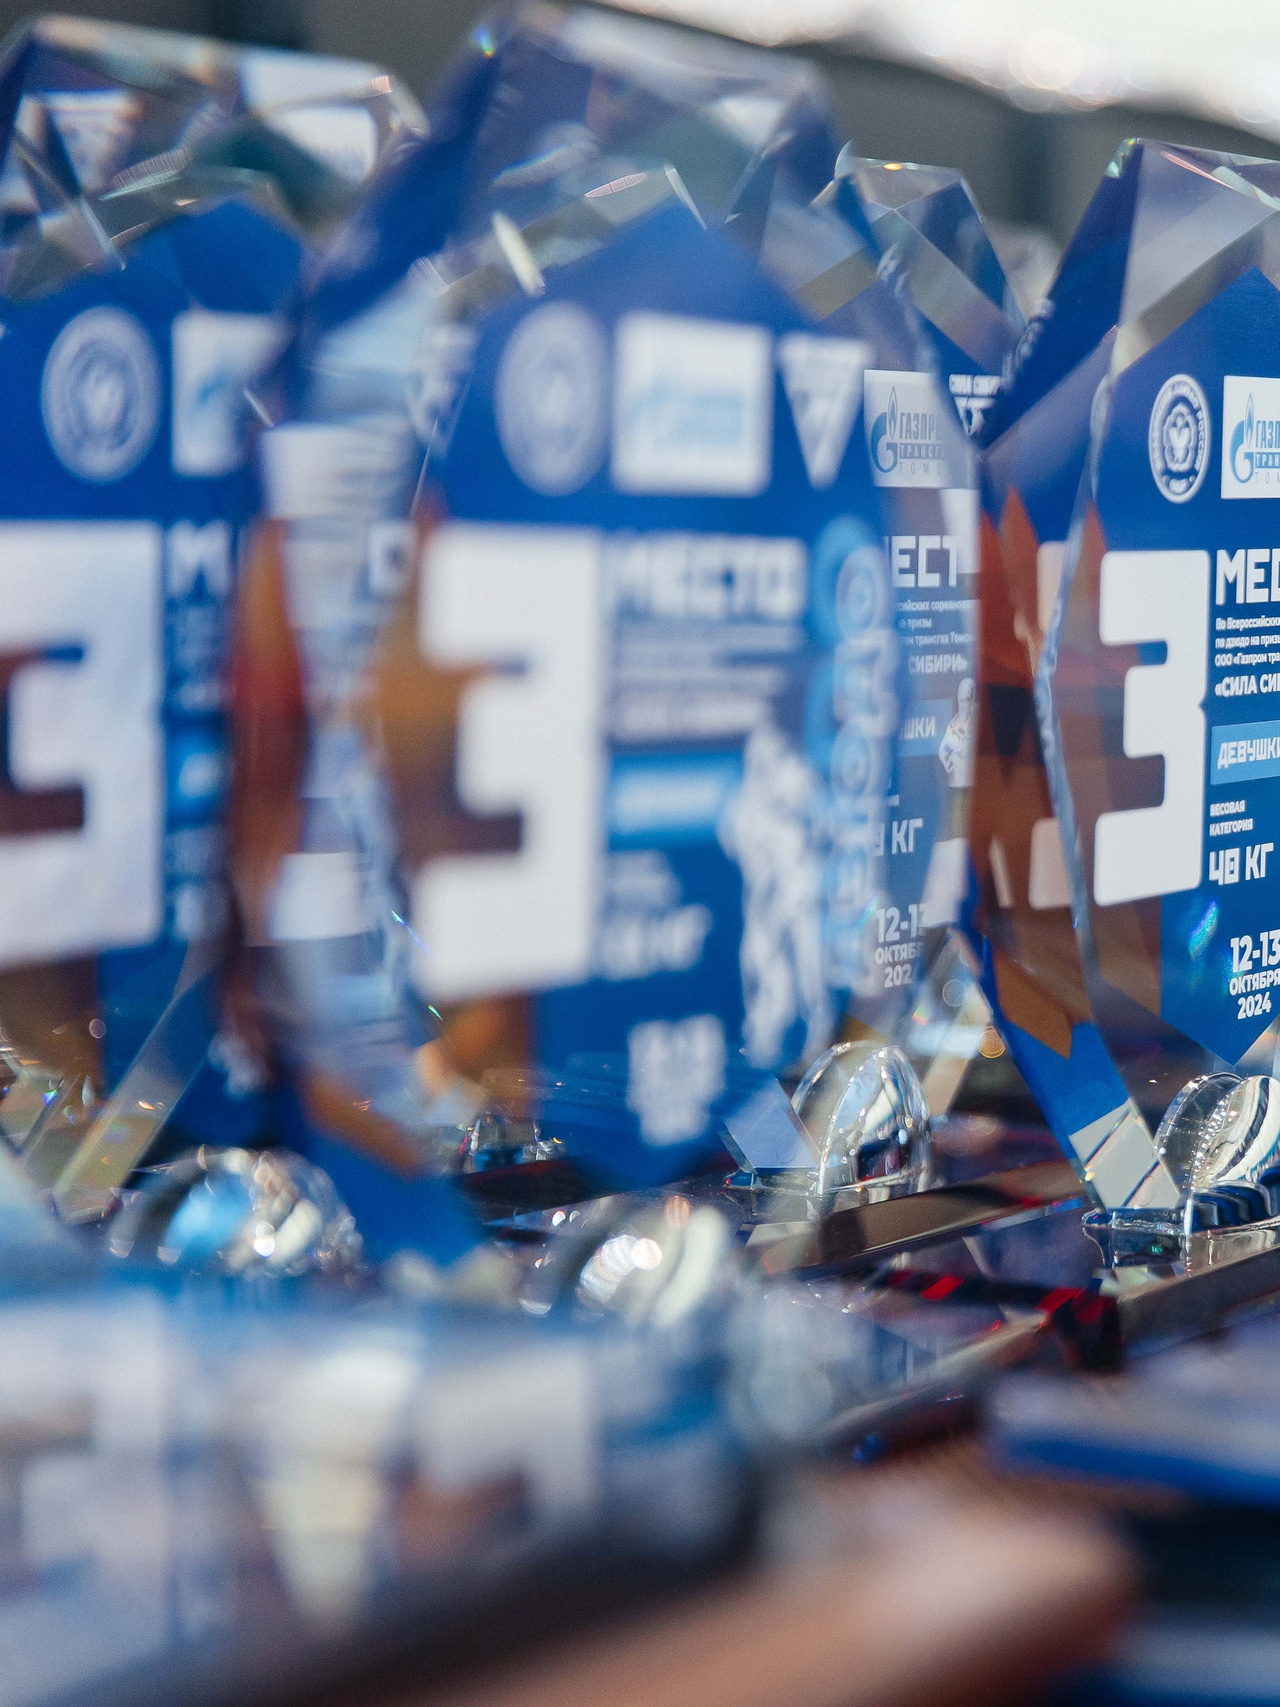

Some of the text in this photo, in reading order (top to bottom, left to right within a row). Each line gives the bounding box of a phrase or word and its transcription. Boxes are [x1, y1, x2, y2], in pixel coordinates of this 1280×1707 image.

[1215, 617, 1226, 631] Во
[1215, 638, 1225, 649] по
[1225, 636, 1250, 650] дзюдо
[1250, 636, 1260, 646] на
[1214, 653, 1233, 667] ООО
[1233, 652, 1267, 666] «Газпром
[1214, 675, 1258, 698] «СИЛА
[1094, 550, 1209, 906] 3
[1210, 800, 1245, 817] ВЕСОВАЯ
[1209, 818, 1253, 836] КАТЕГОРИЯ
[1245, 842, 1274, 880] КГ
[884, 964, 912, 989] 202
[1229, 968, 1280, 996] ОКТЯБРЯ
[1237, 991, 1272, 1020] 2024
